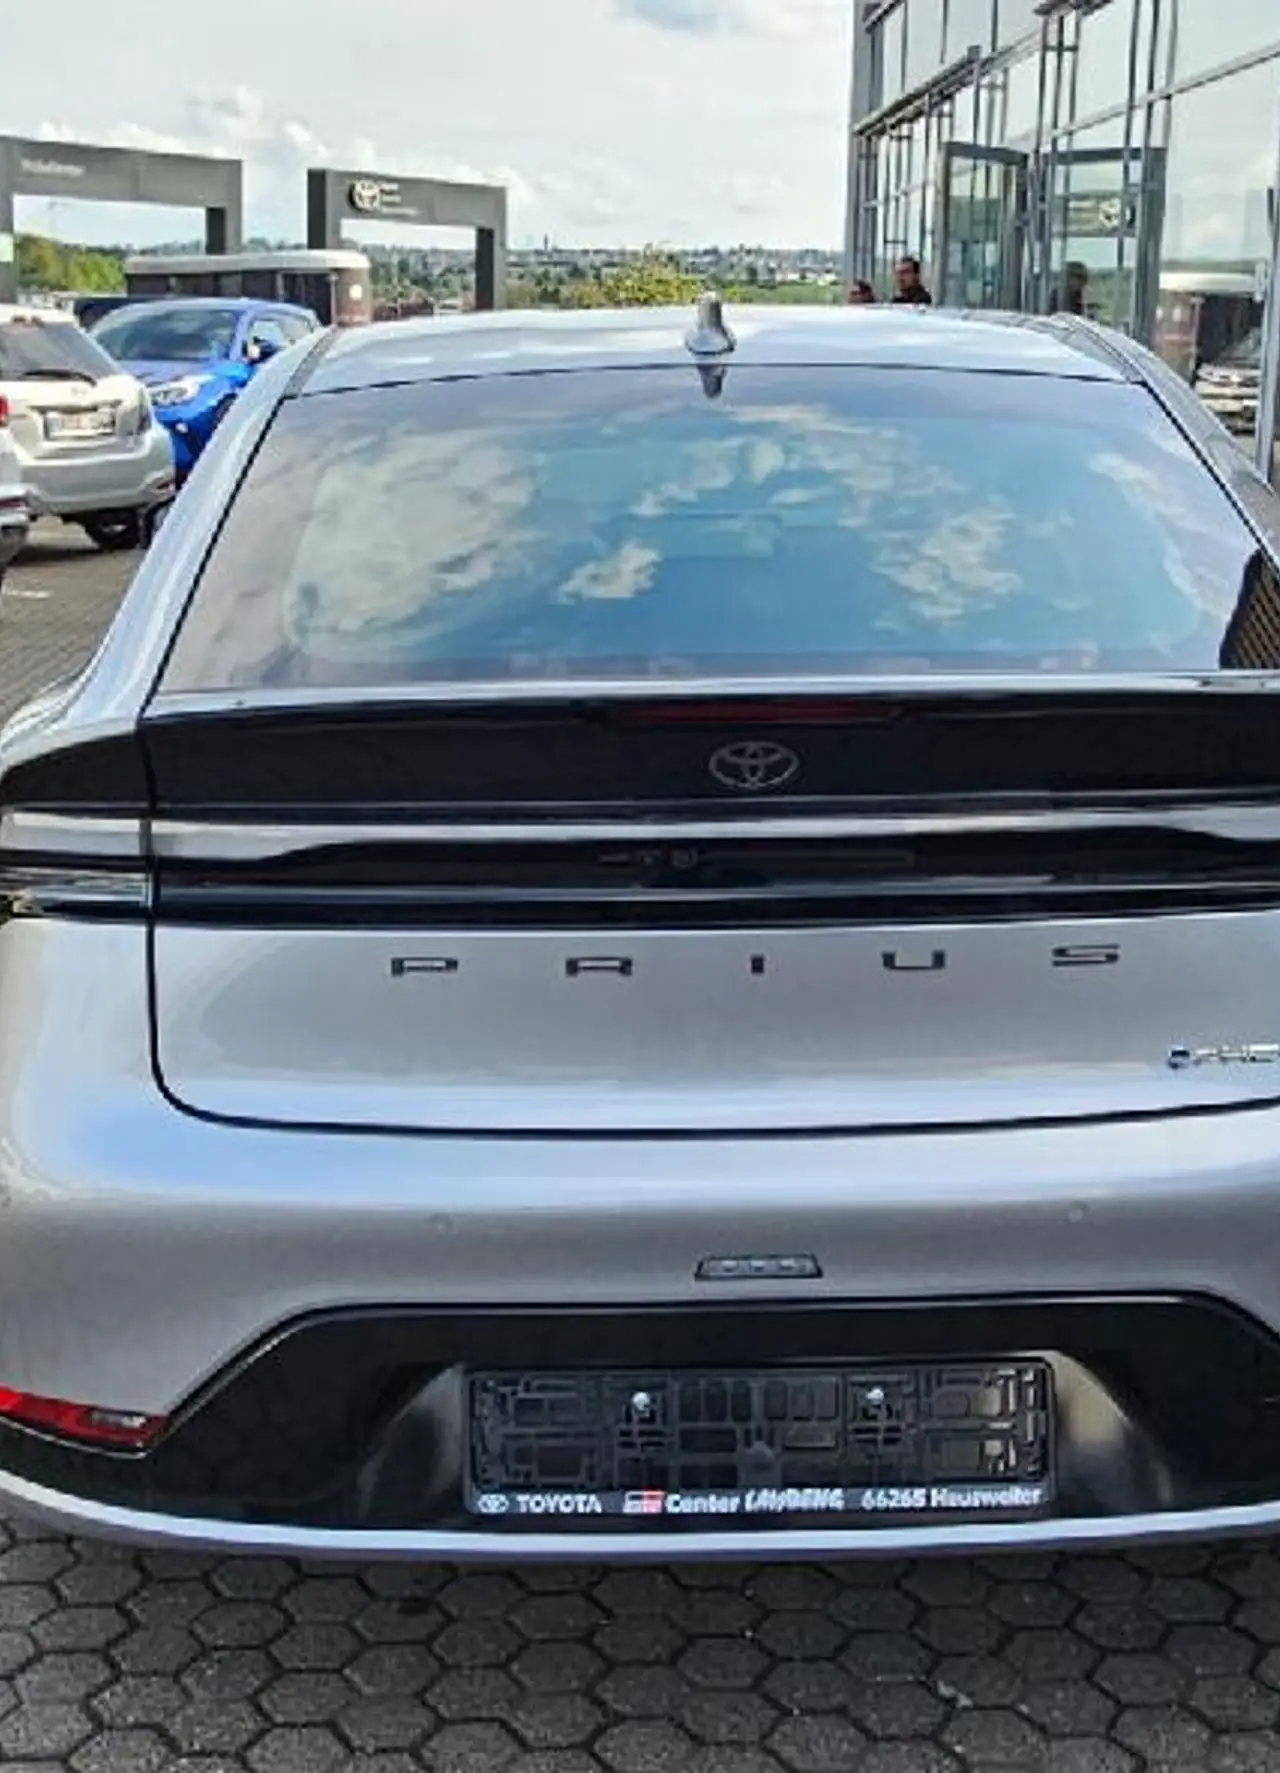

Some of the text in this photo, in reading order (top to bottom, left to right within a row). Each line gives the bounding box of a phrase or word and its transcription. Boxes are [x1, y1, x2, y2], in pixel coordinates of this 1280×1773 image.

[391, 944, 1120, 976] PRIUS
[517, 1493, 603, 1513] TOYOTA
[665, 1493, 740, 1513] Center
[860, 1487, 927, 1511] 66265
